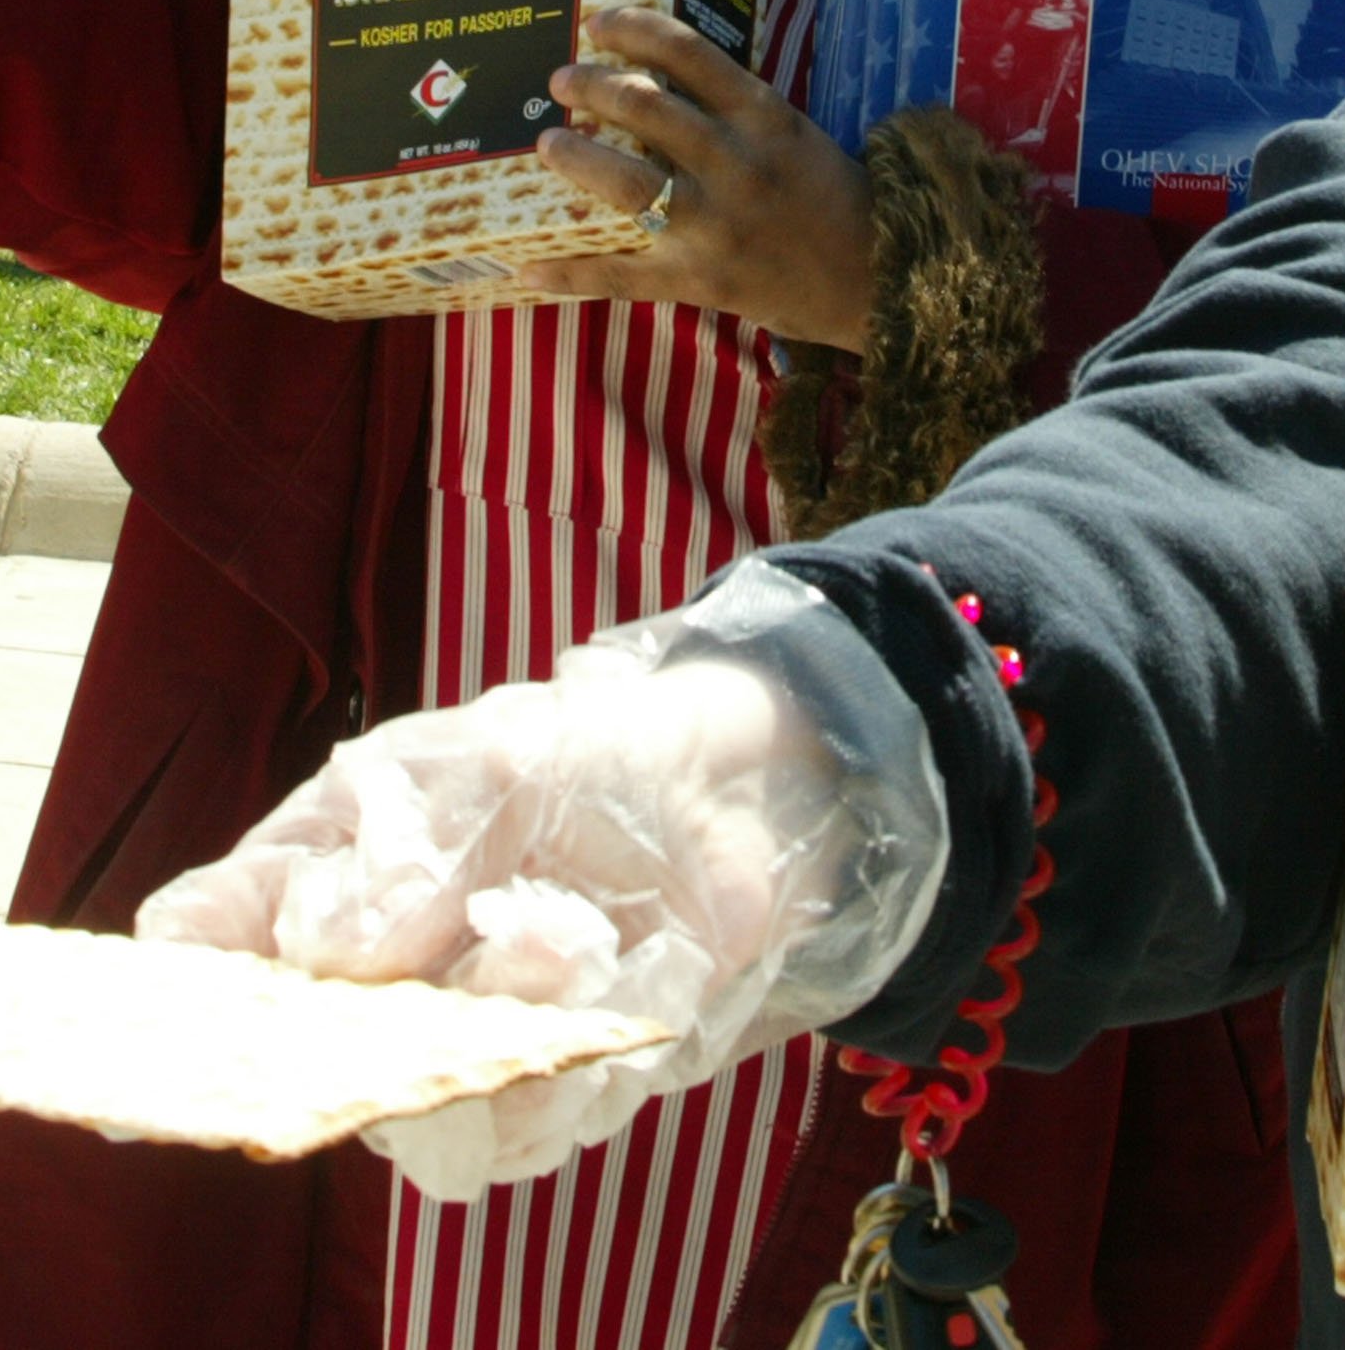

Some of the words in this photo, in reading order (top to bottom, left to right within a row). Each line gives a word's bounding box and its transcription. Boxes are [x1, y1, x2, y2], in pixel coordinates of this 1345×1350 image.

[360, 23, 418, 47] KOSHER
[425, 19, 454, 40] FOR
[459, 7, 532, 35] PASSOVER
